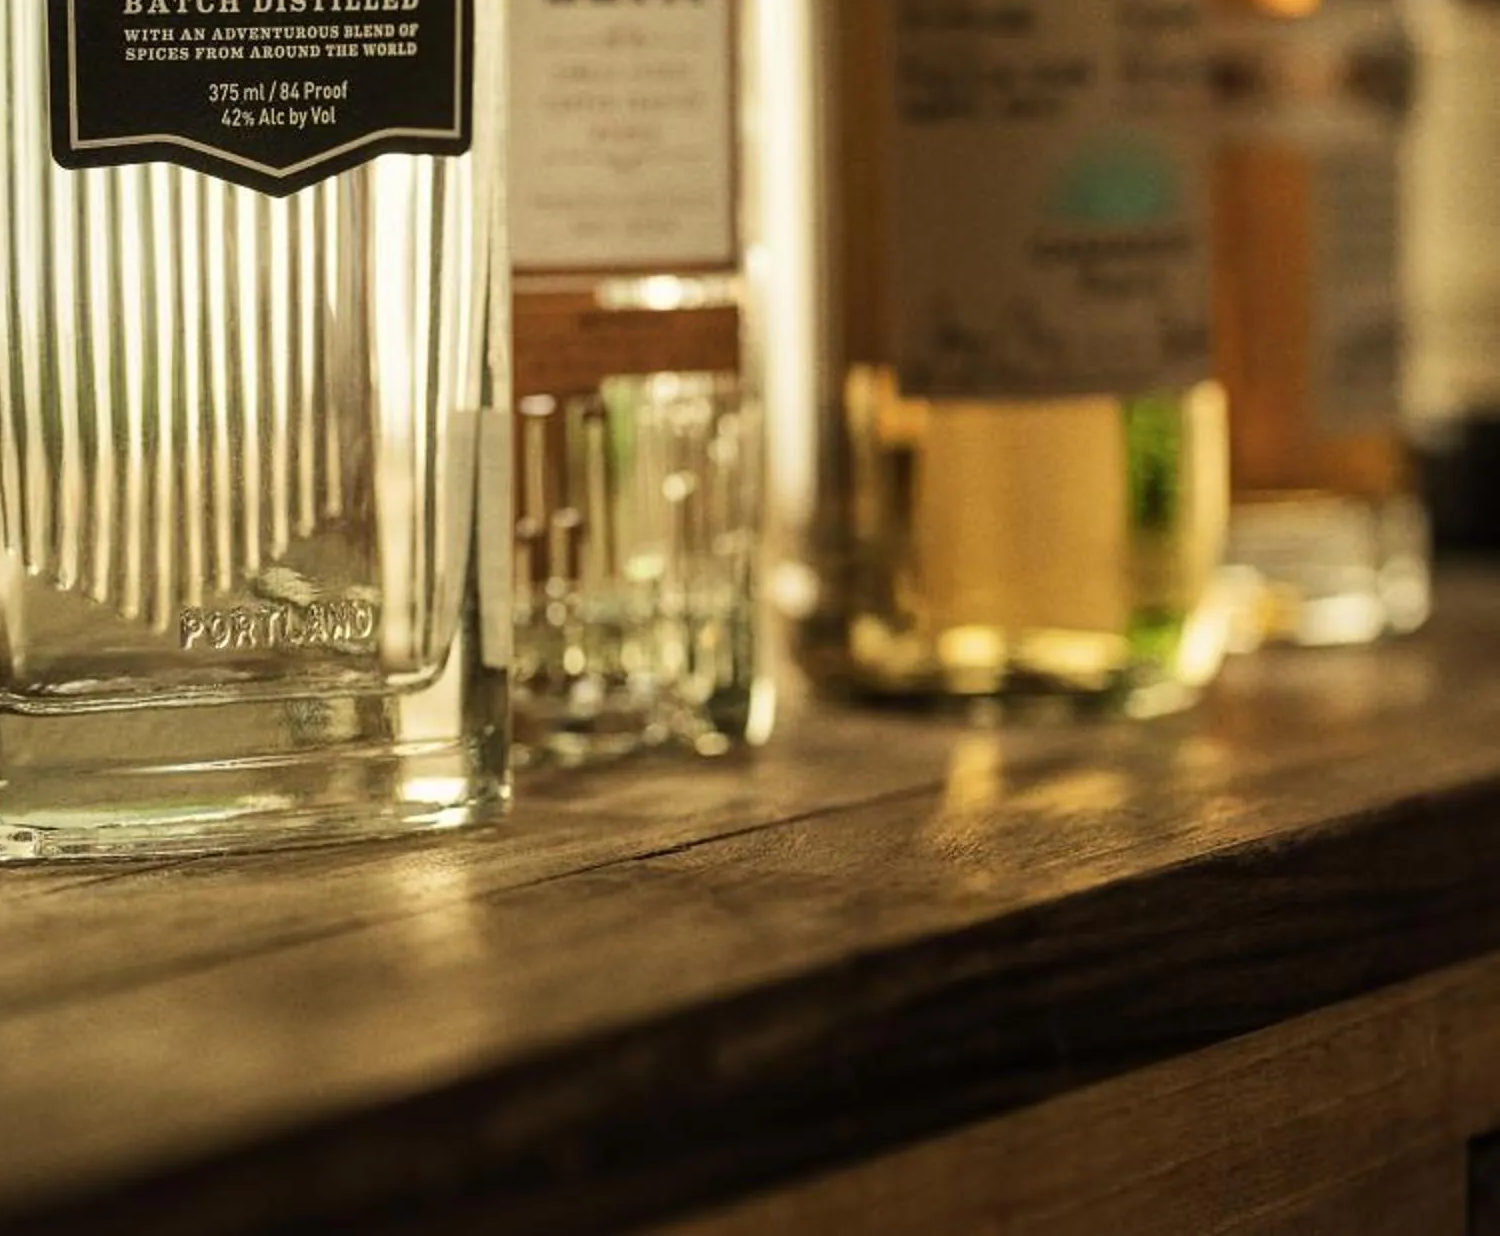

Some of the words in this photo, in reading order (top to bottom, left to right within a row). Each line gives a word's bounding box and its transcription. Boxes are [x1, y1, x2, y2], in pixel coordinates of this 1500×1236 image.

[124, 29, 174, 41] WITH
[180, 28, 205, 40] AN
[212, 25, 339, 40] ADVENTUROUS
[344, 24, 395, 38] BLEND
[399, 23, 418, 37] OF
[126, 48, 189, 60] SPICES
[196, 46, 244, 59] FROM
[250, 45, 320, 58] AROUND
[325, 44, 358, 57] THE
[363, 42, 417, 56] WORLD
[209, 84, 239, 102] 375
[244, 84, 265, 100] ml
[280, 82, 299, 100] 84
[304, 80, 347, 99] Proof
[222, 108, 254, 126] 42%
[259, 108, 284, 125] Alc
[290, 108, 307, 129] by
[311, 106, 336, 124] Vol
[180, 600, 373, 650] PORTLAND
